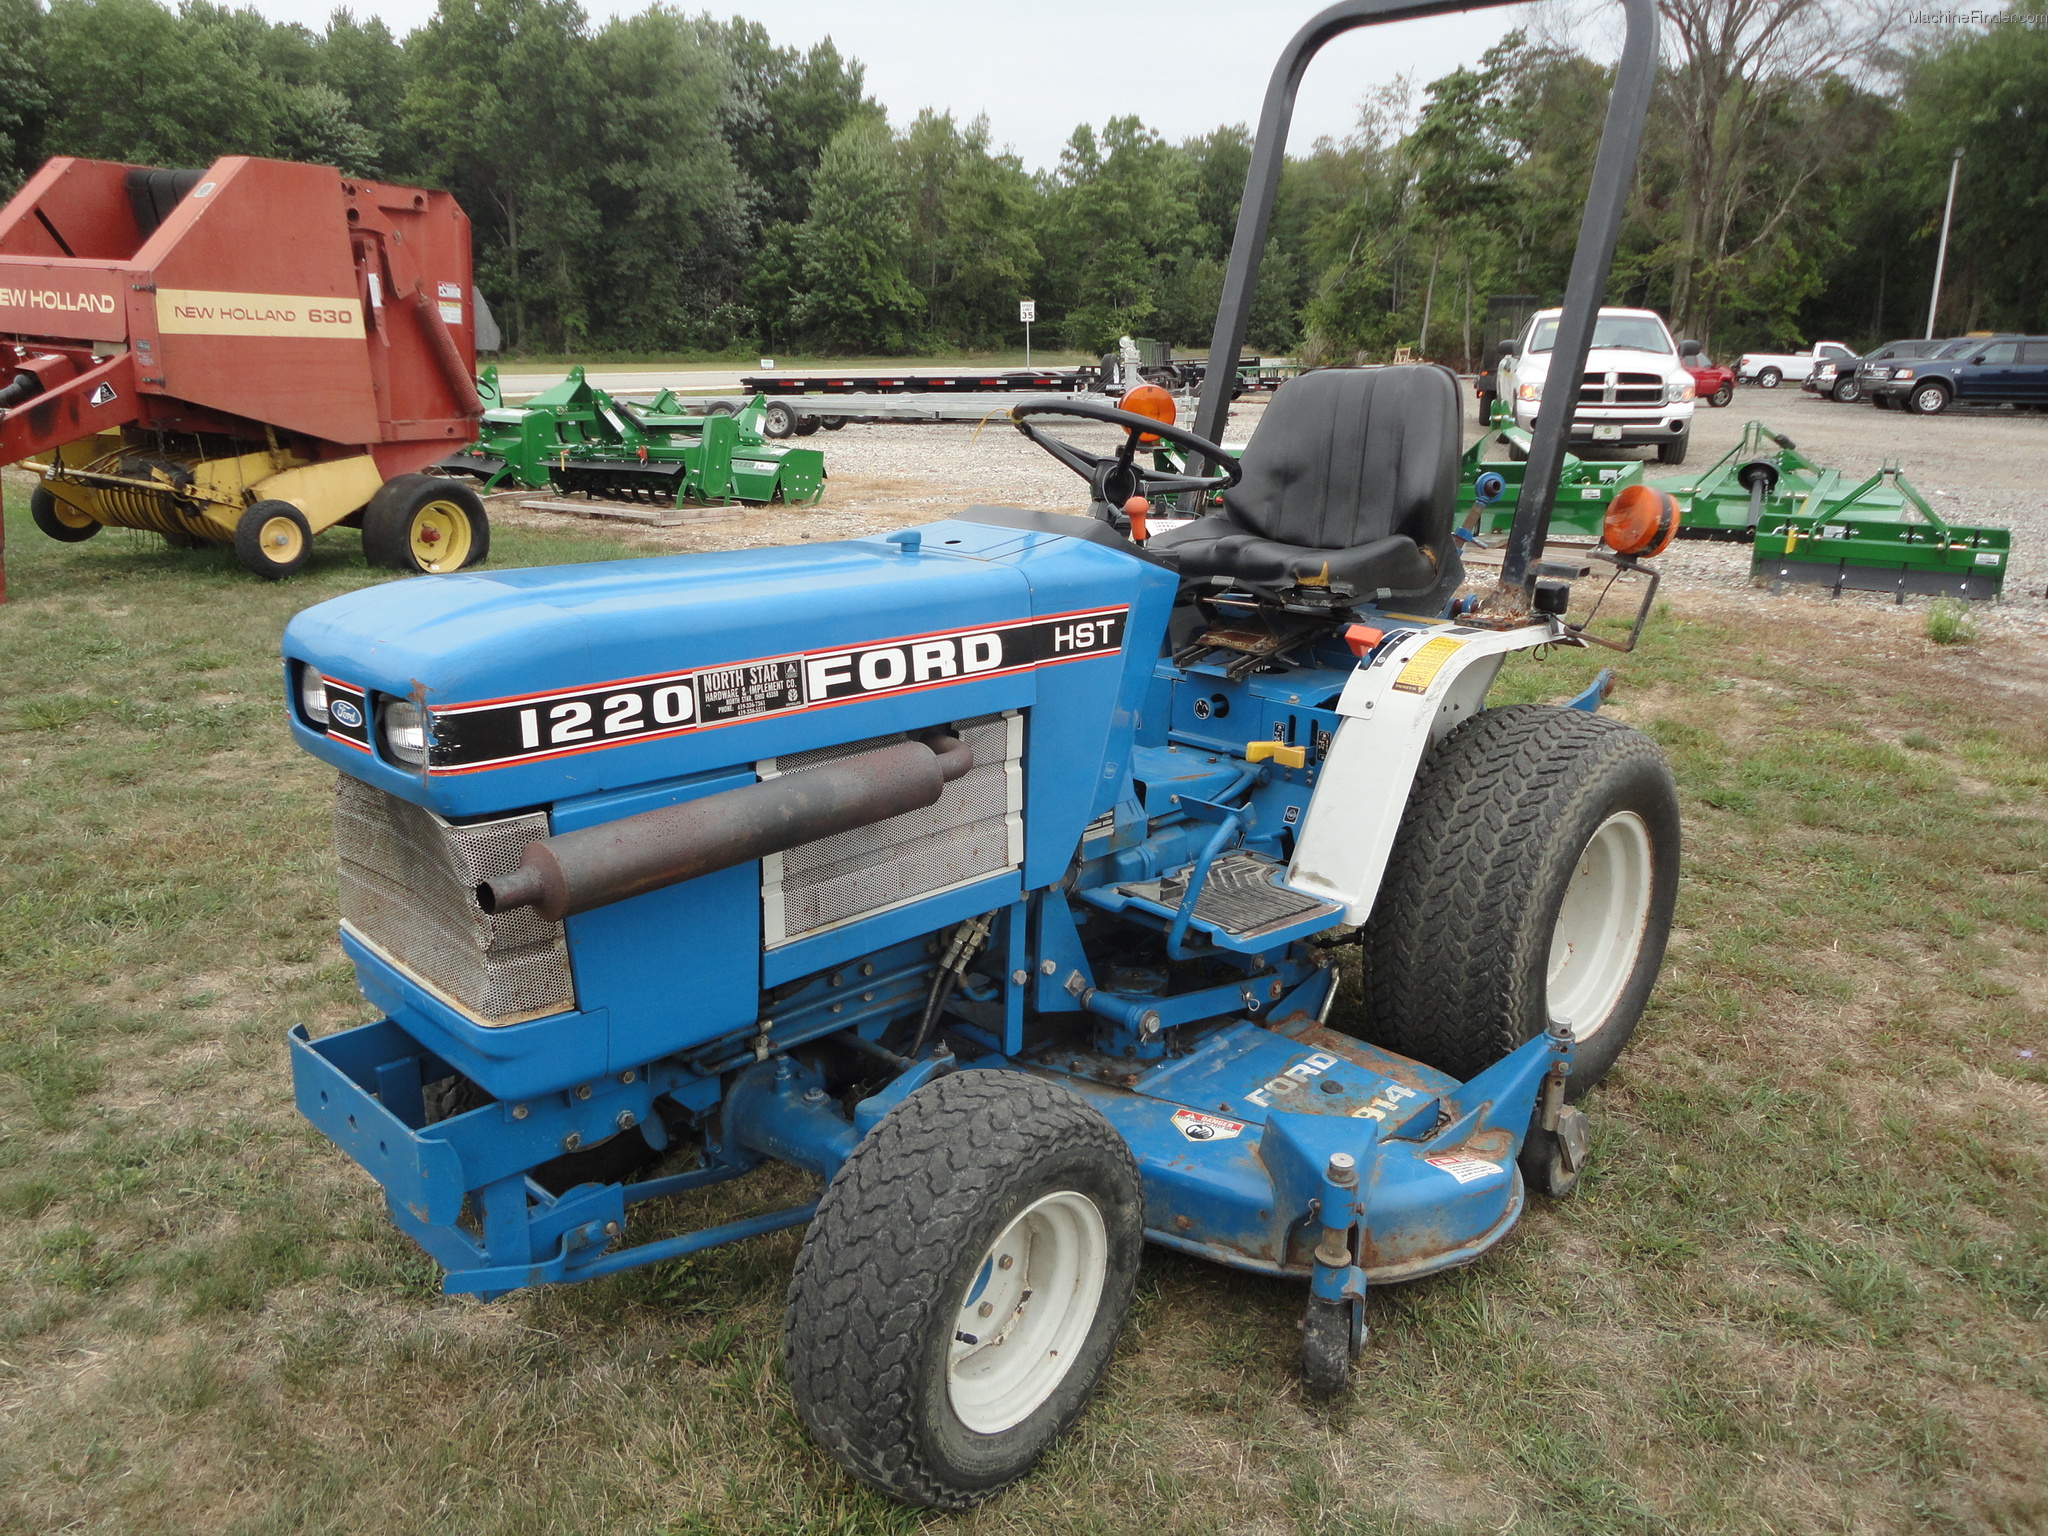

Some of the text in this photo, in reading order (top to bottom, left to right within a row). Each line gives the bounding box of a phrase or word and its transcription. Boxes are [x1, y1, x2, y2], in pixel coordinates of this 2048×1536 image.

[0, 288, 115, 314] EW HOLLAND
[174, 306, 352, 324] NEW HOLLAND 630
[1055, 619, 1115, 652] HST
[703, 663, 779, 693] NORTH STAR
[807, 633, 1003, 701] FORD
[704, 688, 739, 703] HARDWARE
[749, 680, 784, 695] IMPLEMENT
[785, 678, 797, 689] CO.
[726, 696, 740, 705] NORTH
[337, 702, 355, 722] Ford
[520, 685, 694, 749] 1220
[1243, 1052, 1338, 1108] FORD
[1351, 1084, 1417, 1123] 914
[1201, 1116, 1235, 1129] DANGER
